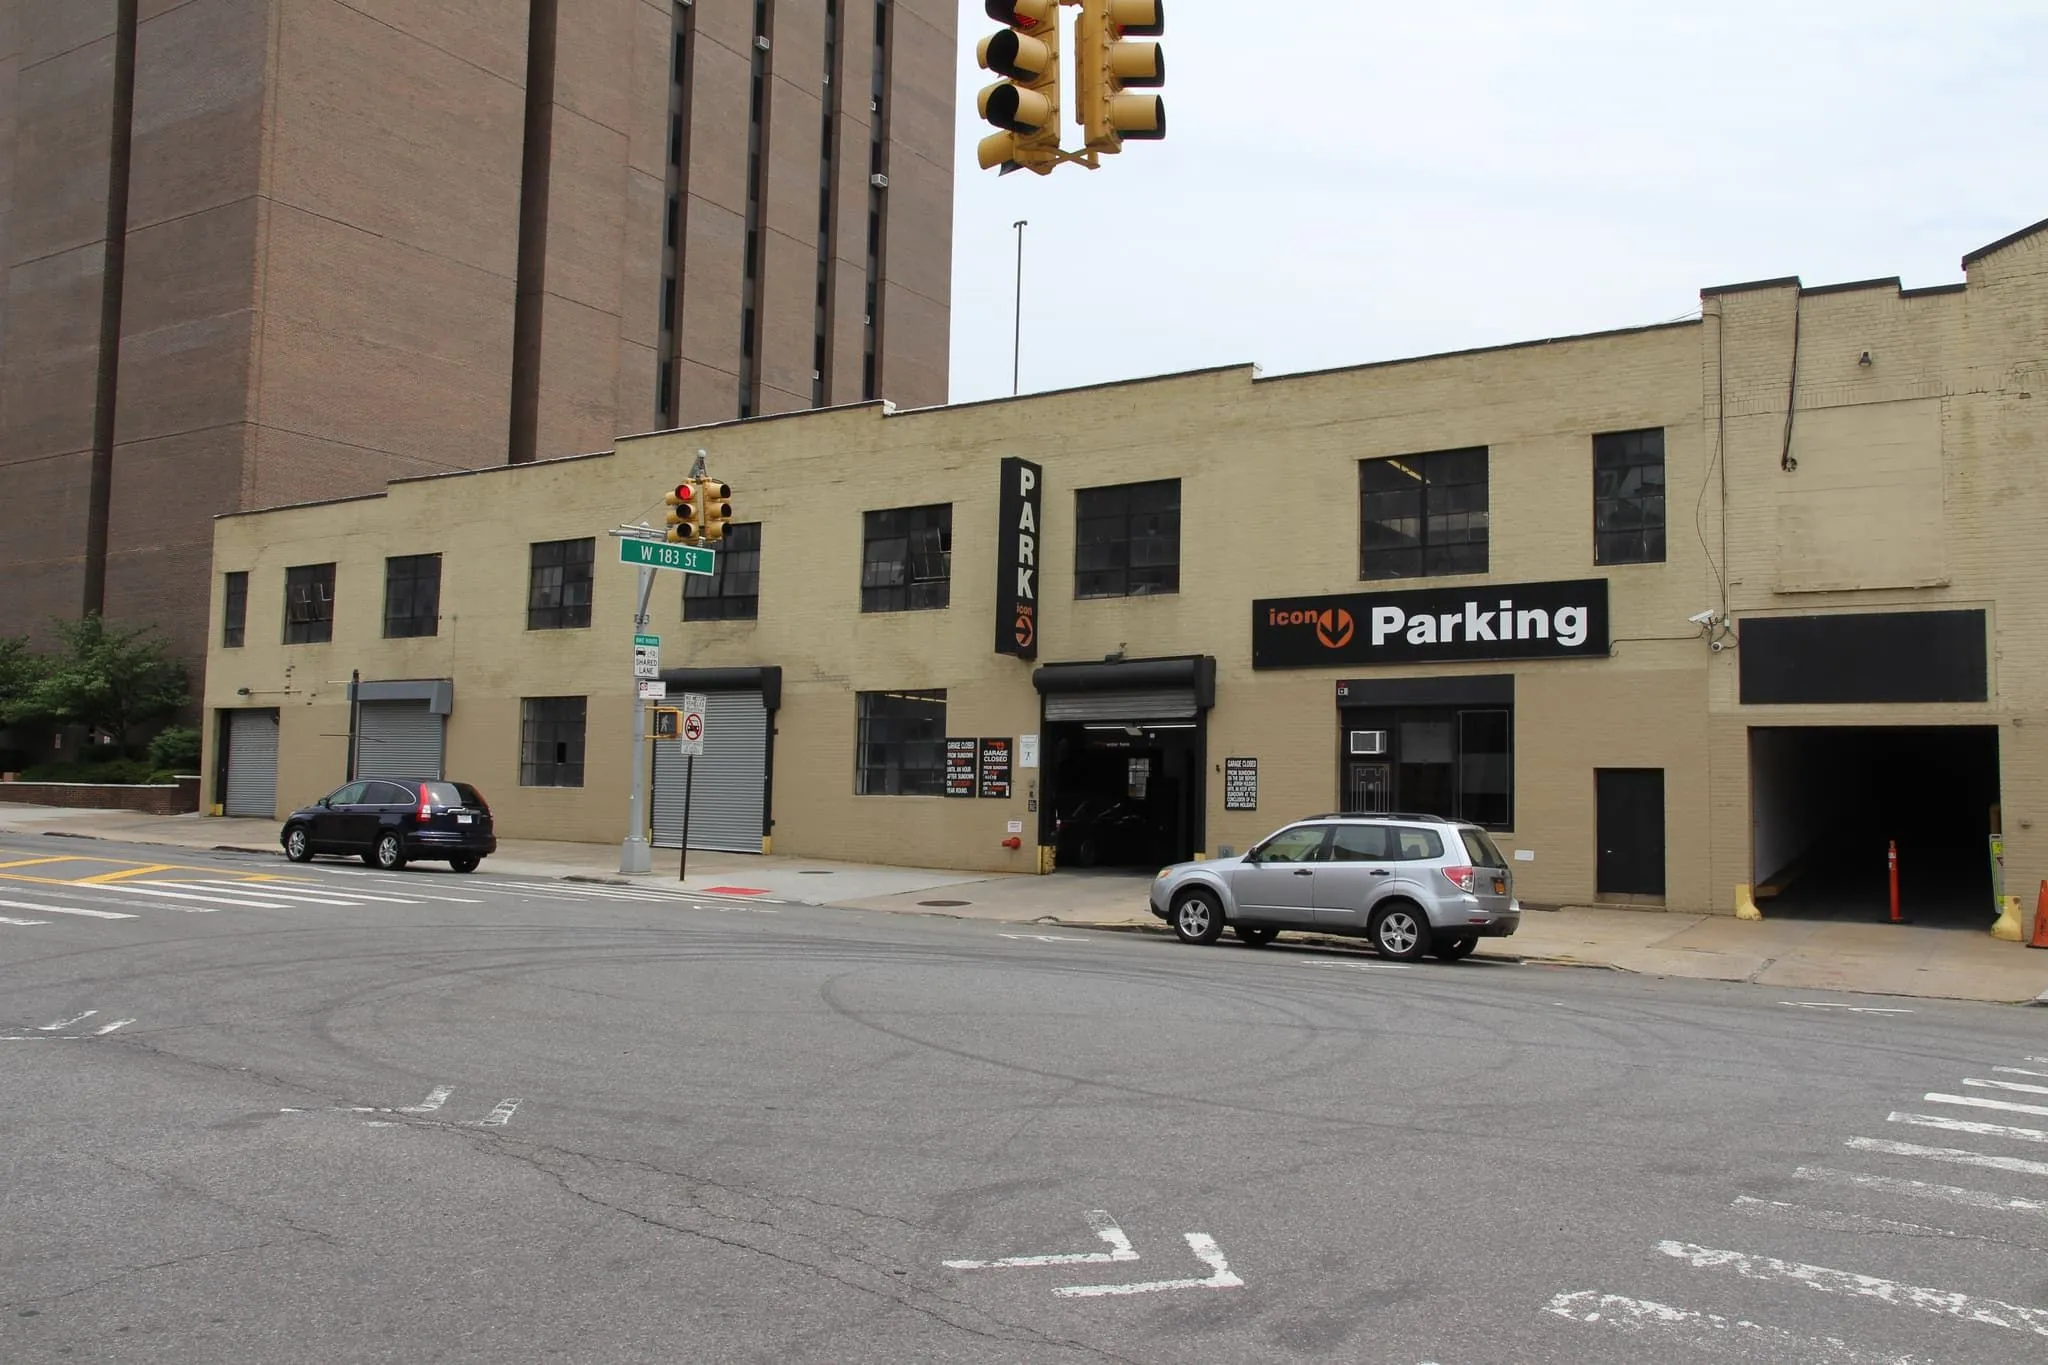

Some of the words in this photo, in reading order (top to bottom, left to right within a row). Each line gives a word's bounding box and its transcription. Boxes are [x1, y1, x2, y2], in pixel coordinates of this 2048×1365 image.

[1018, 467, 1035, 599] PARK
[641, 545, 653, 560] W
[659, 548, 680, 565] 183
[685, 552, 697, 567] St
[1016, 602, 1033, 616] icon
[1269, 608, 1318, 626] icon
[1371, 600, 1588, 647] Parking
